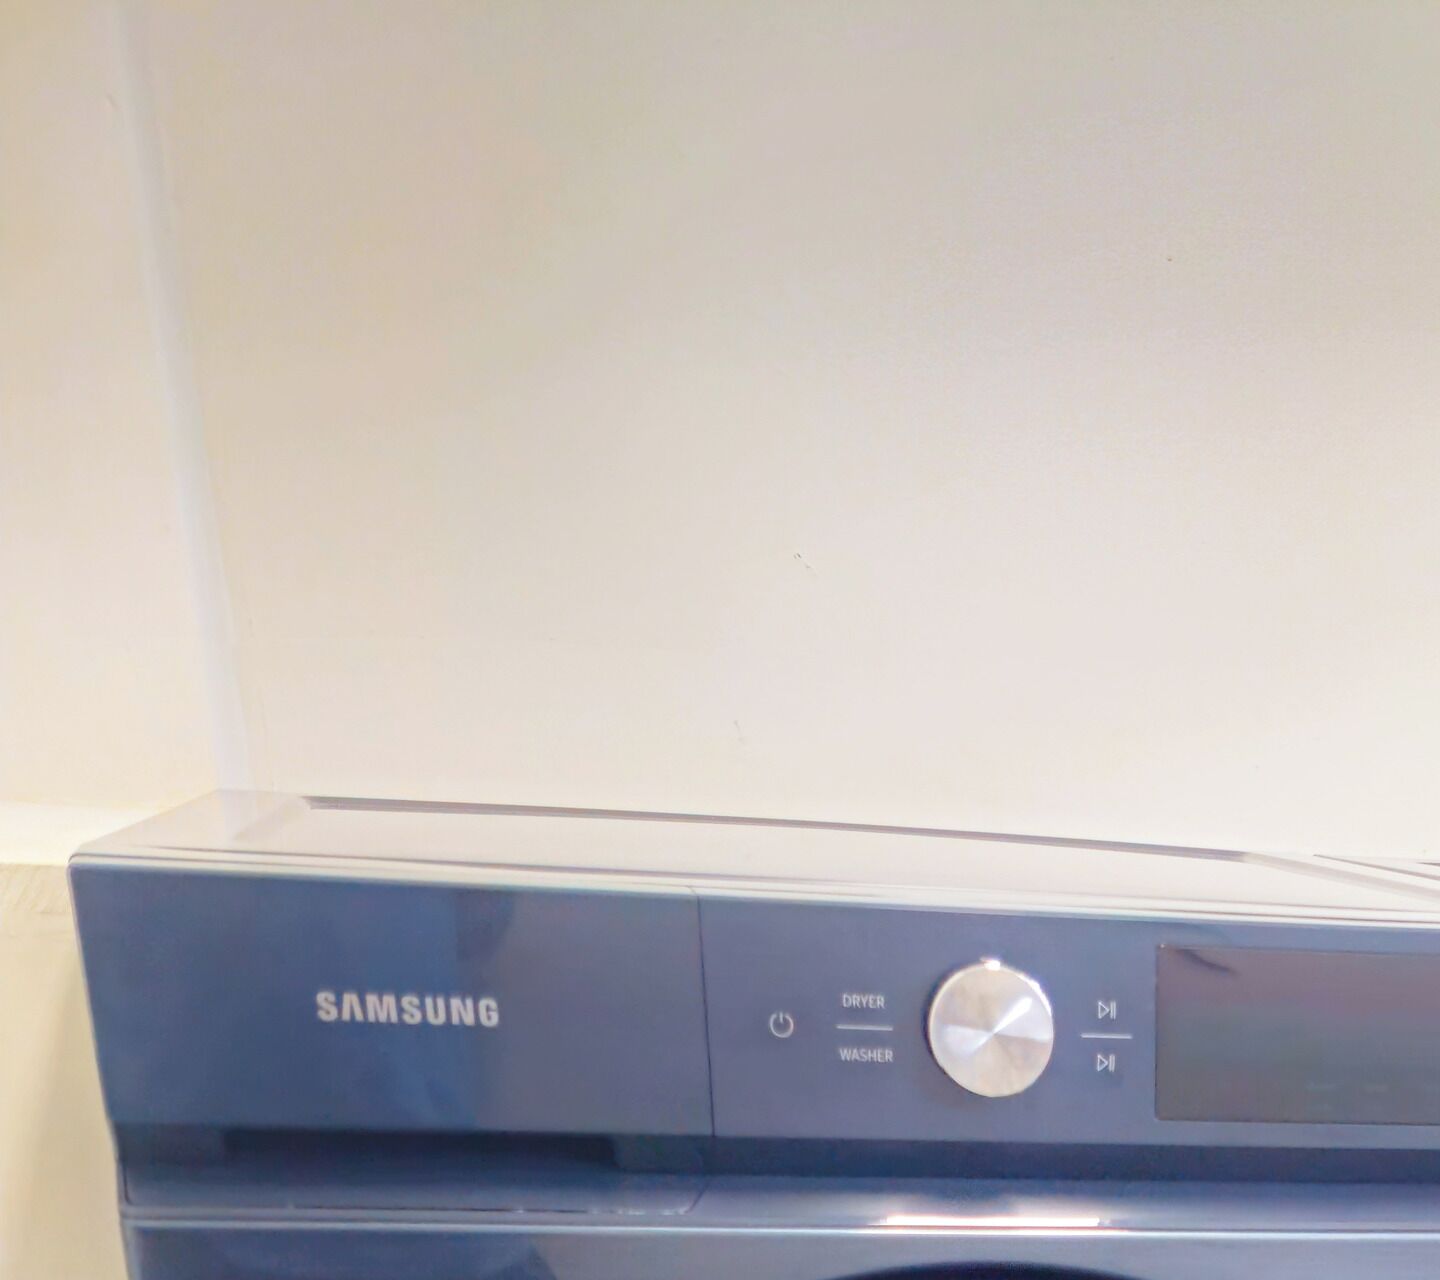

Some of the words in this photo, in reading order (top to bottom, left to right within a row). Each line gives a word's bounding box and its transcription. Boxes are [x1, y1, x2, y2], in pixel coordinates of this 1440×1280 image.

[842, 993, 885, 1008] DRYER
[315, 990, 499, 1028] SAMSUNG
[839, 1048, 893, 1063] WASHER
